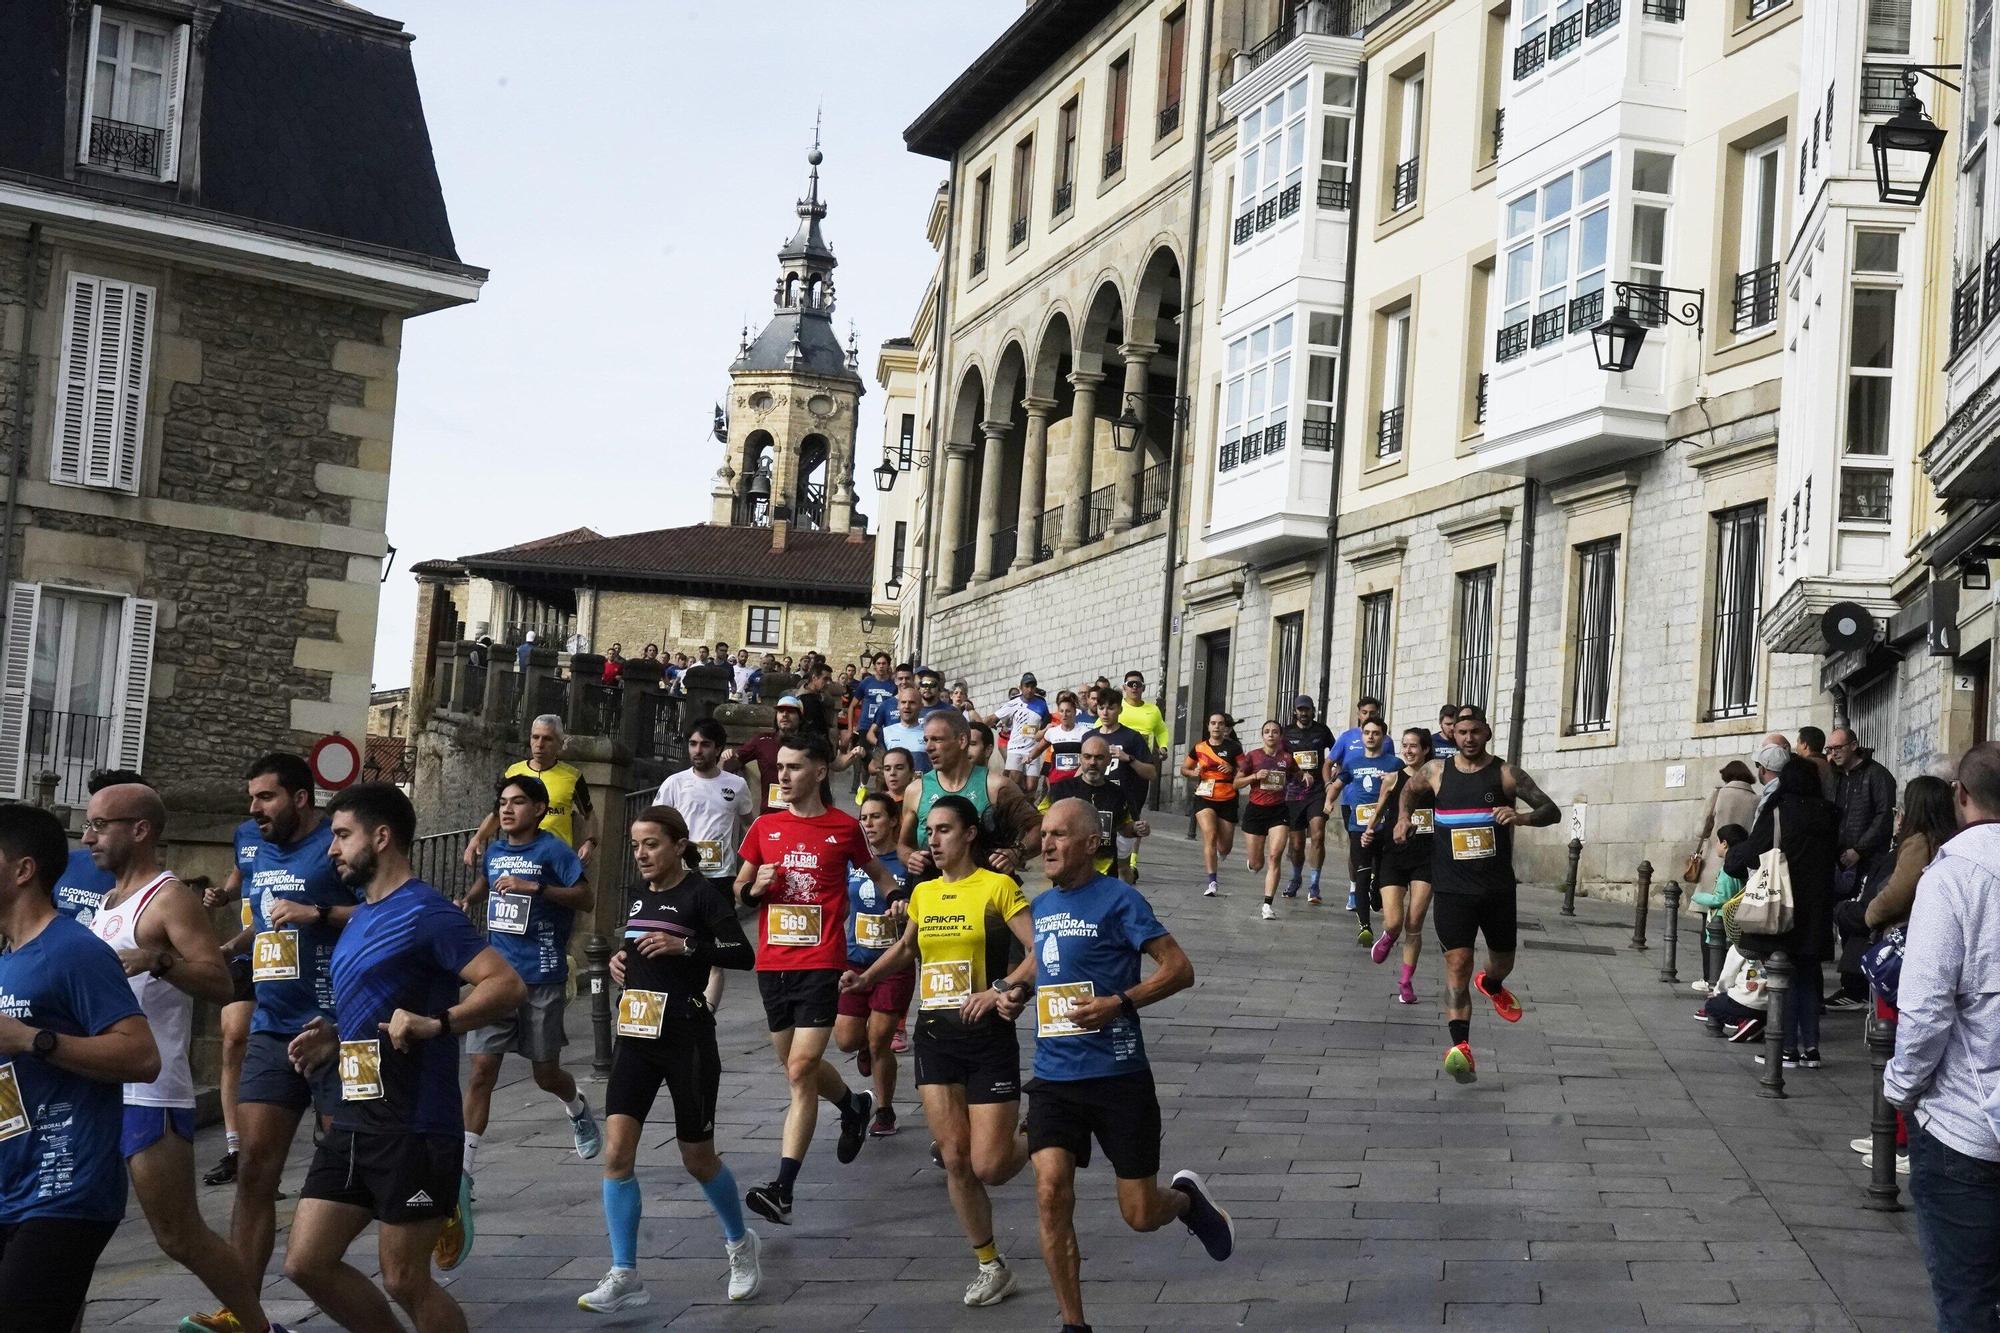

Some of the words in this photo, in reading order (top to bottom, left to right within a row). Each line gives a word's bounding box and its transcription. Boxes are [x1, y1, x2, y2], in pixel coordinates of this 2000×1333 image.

[1962, 677, 1968, 689] 2
[1466, 835, 1481, 848] 55
[494, 861, 532, 870] ALMENDRA
[254, 874, 295, 887] ALMENDRA
[272, 883, 306, 892] KONKISTA
[494, 902, 519, 919] 1076
[780, 915, 807, 931] 569
[866, 922, 886, 937] 451
[1039, 919, 1086, 933] ALMENDRA
[1057, 928, 1099, 938] KONKISTA
[260, 943, 281, 962] 574
[930, 973, 954, 993] 475
[15, 999, 31, 1007] REN
[628, 1001, 649, 1020] 197
